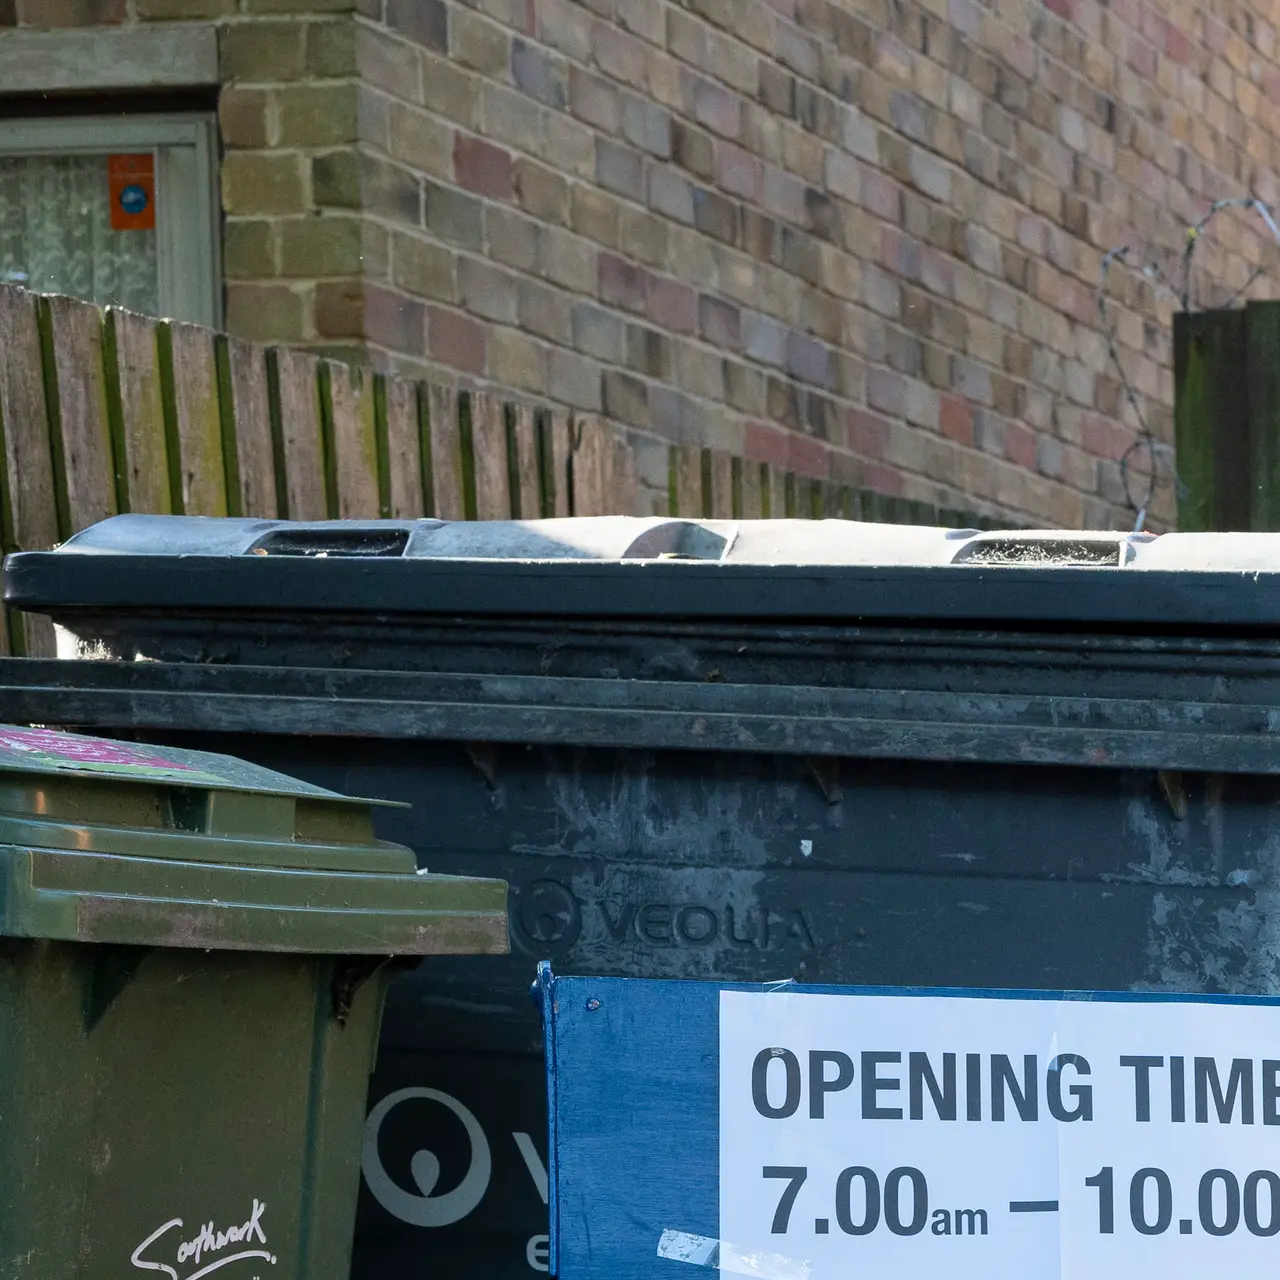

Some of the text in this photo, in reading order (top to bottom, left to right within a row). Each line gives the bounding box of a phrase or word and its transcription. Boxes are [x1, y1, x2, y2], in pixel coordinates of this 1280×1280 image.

[596, 900, 816, 948] VEOLIA
[752, 1047, 1093, 1123] OPENING
[762, 1165, 988, 1237] 7.00am
